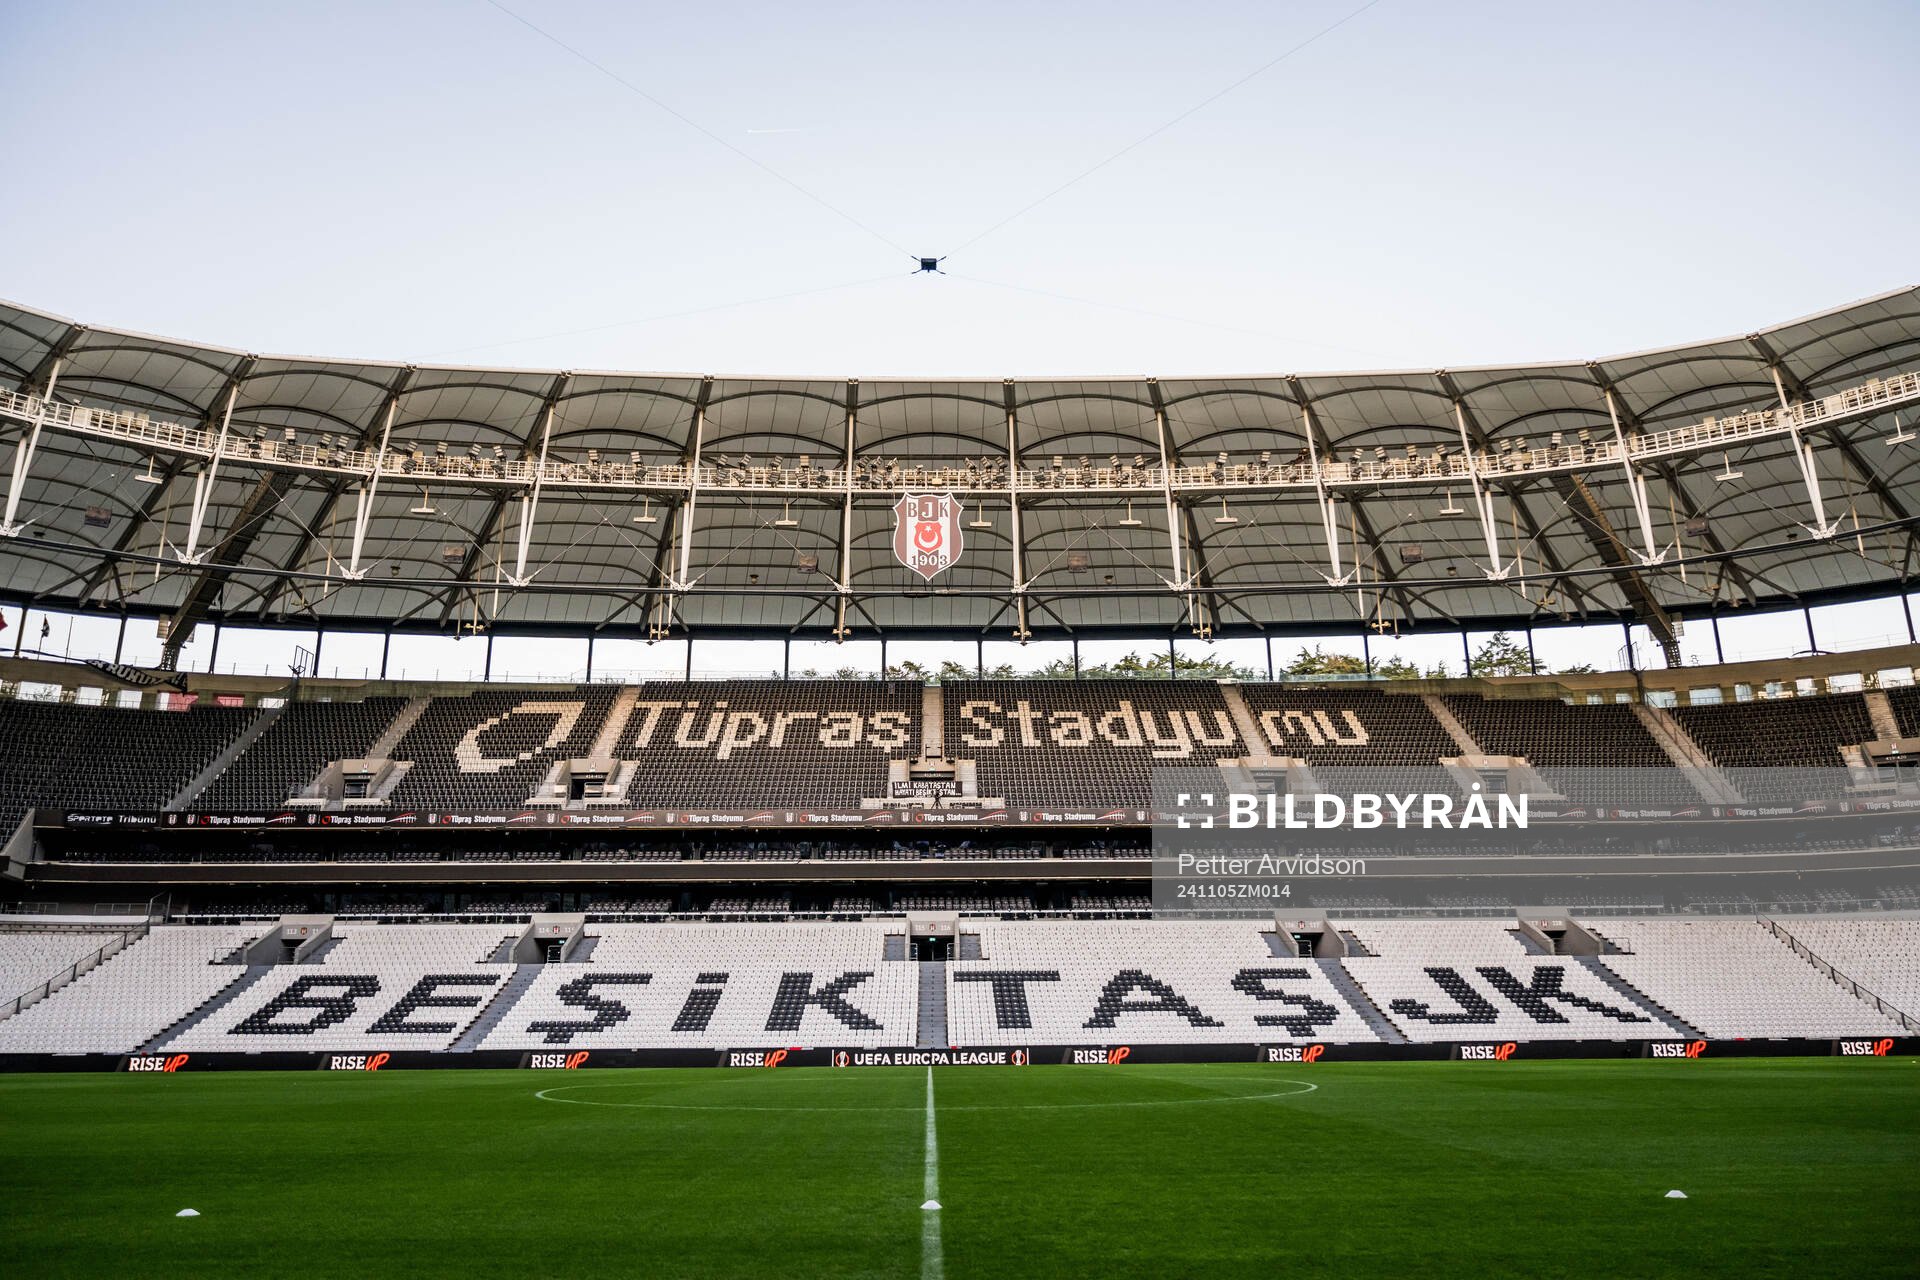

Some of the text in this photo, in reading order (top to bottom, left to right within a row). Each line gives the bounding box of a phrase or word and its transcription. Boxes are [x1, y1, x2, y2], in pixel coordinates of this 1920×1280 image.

[908, 501, 949, 519] BJK
[911, 554, 948, 567] 1903
[634, 700, 911, 760] Tüpraş
[854, 1053, 891, 1066] UEFA
[952, 1052, 1007, 1065] LEAGUE
